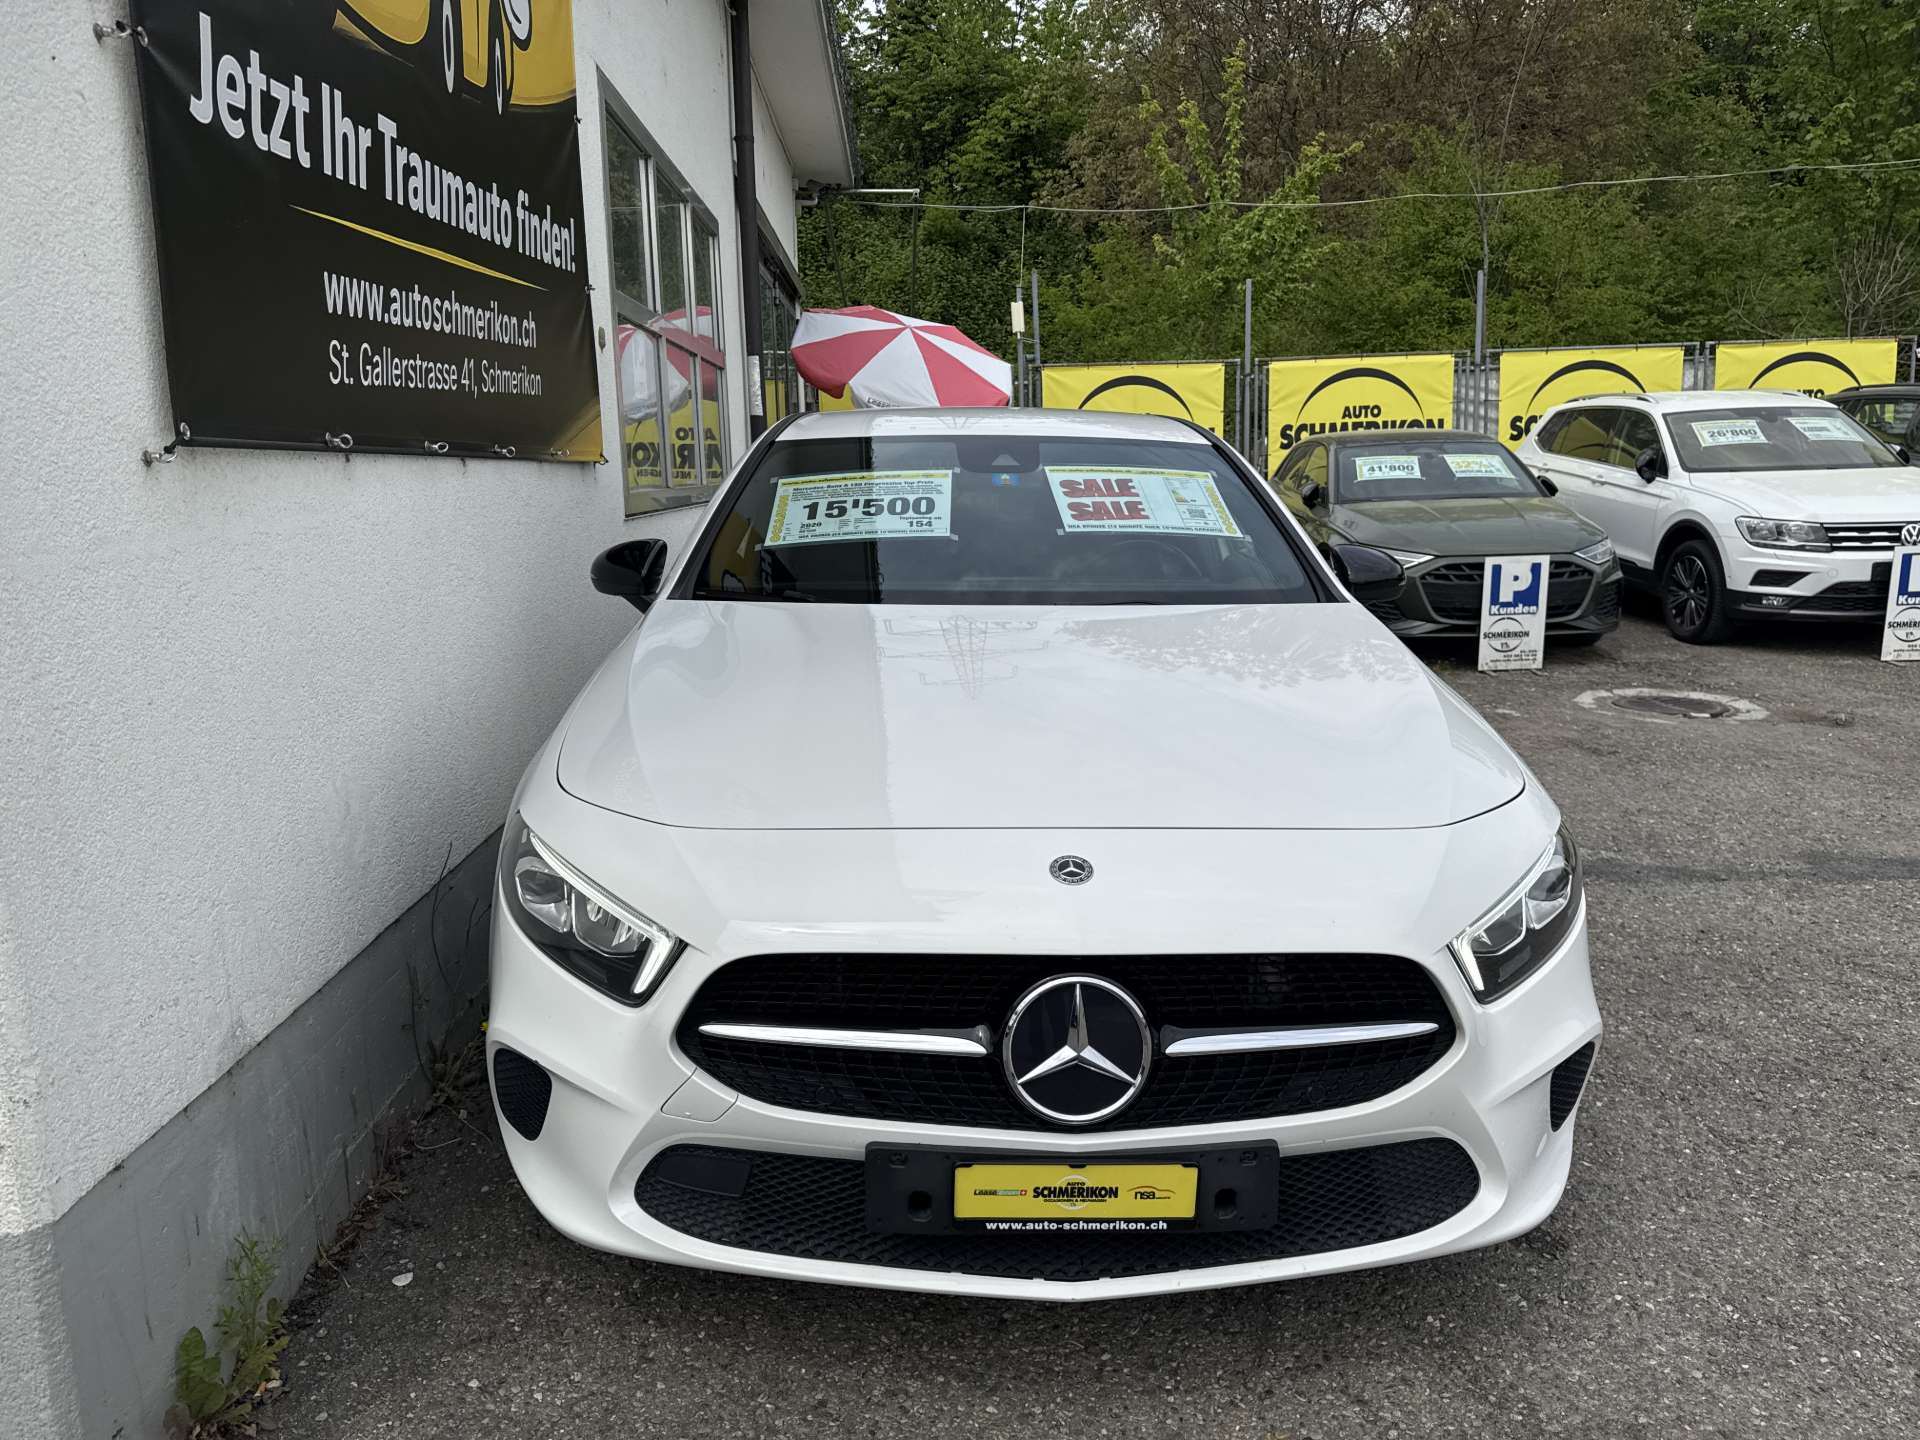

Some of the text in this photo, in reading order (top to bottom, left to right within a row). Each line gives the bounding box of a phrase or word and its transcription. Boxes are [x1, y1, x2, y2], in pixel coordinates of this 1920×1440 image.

[189, 11, 576, 272] Jetzt Ihr Traumauto finden!
[323, 271, 537, 348] www.autoschmerikon.ch
[329, 339, 542, 400] St. Gallerstrasse 41, Schmerikon
[1342, 405, 1382, 419] AUTO
[1707, 428, 1757, 438] 26'800
[1367, 464, 1414, 473] 41'800
[1059, 478, 1140, 498] SALE
[803, 496, 936, 520] 15'500
[1067, 500, 1150, 521] SALE
[1490, 603, 1538, 615] Kunden
[1483, 631, 1530, 639] SCHMERIKON
[1032, 1186, 1118, 1199] SCHMERIKON
[1135, 1190, 1156, 1200] nsa
[985, 1220, 1168, 1230] www.auto-schmerikon.ch
